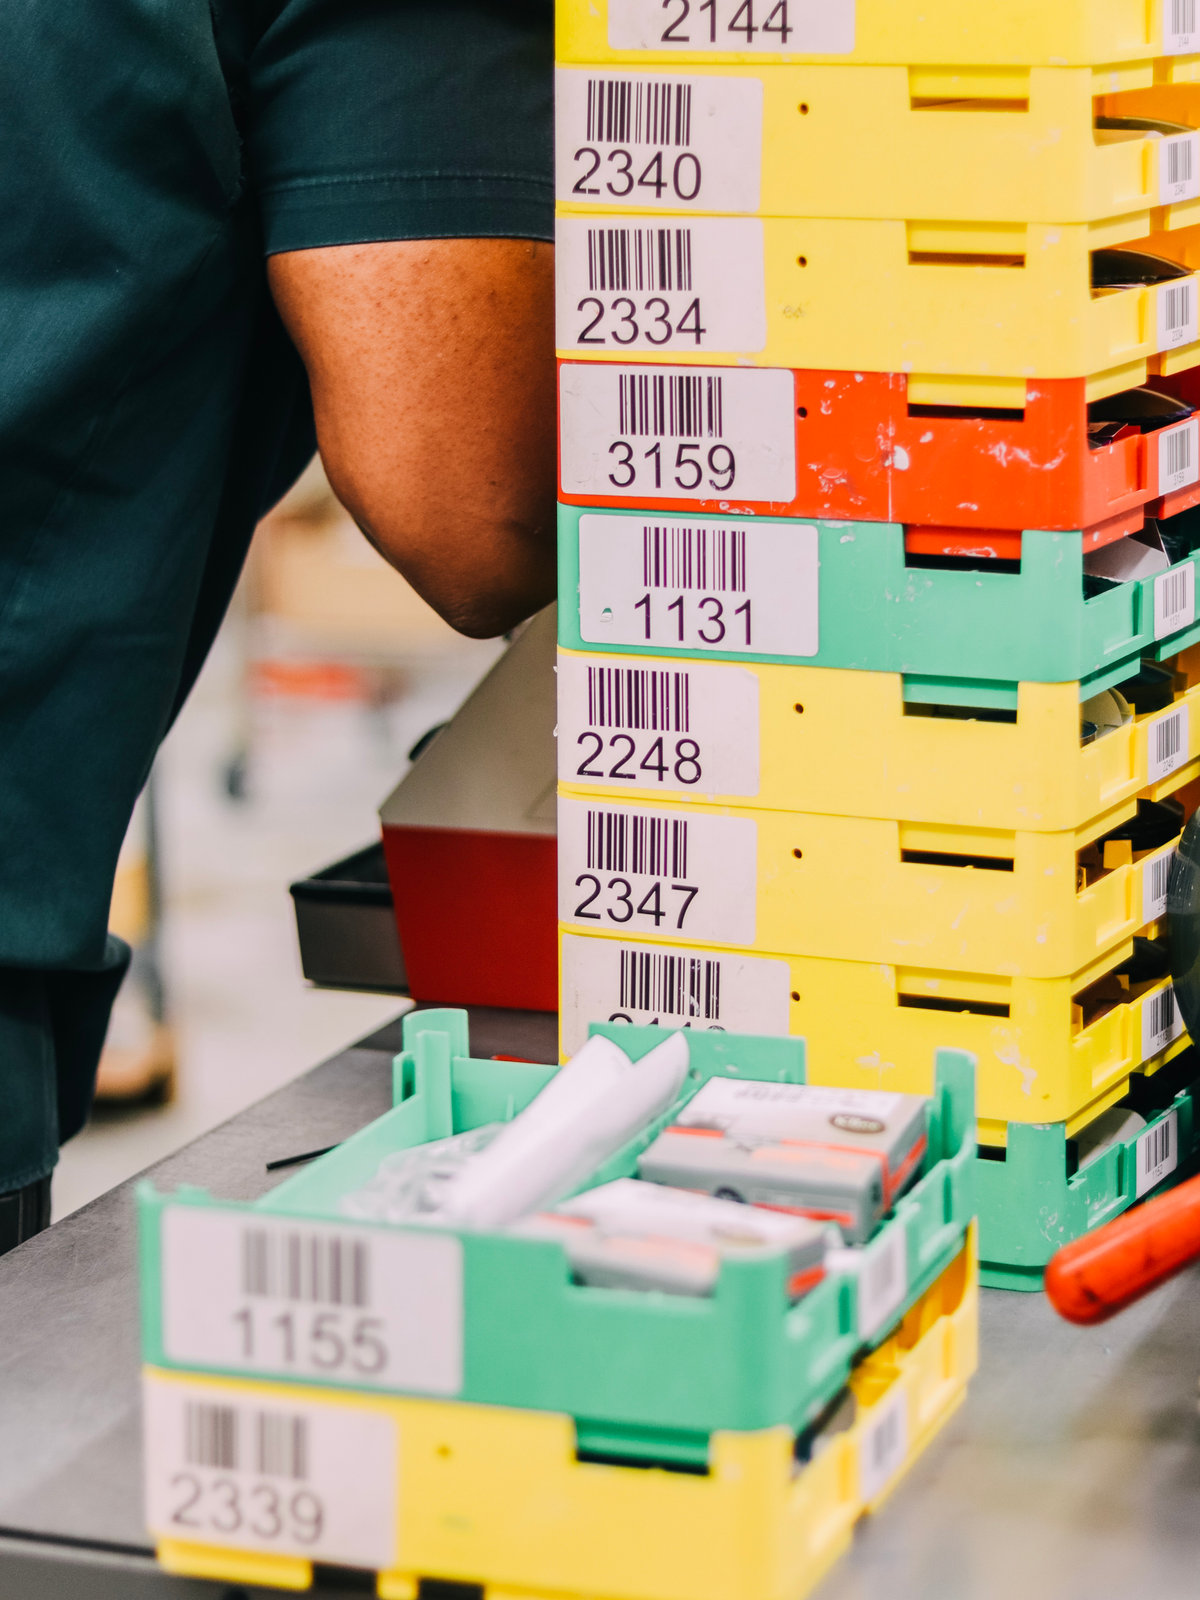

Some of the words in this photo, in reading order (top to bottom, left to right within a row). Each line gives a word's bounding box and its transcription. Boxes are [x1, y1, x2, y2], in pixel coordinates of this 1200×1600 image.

[660, 0, 794, 44] 2144
[572, 147, 702, 201] 2340
[576, 296, 707, 346] 2334
[607, 440, 736, 491] 3159
[634, 593, 752, 646] 1131
[576, 731, 703, 785] 2248
[573, 873, 699, 929] 2347
[232, 1305, 390, 1376] 1155
[169, 1472, 327, 1546] 2339
